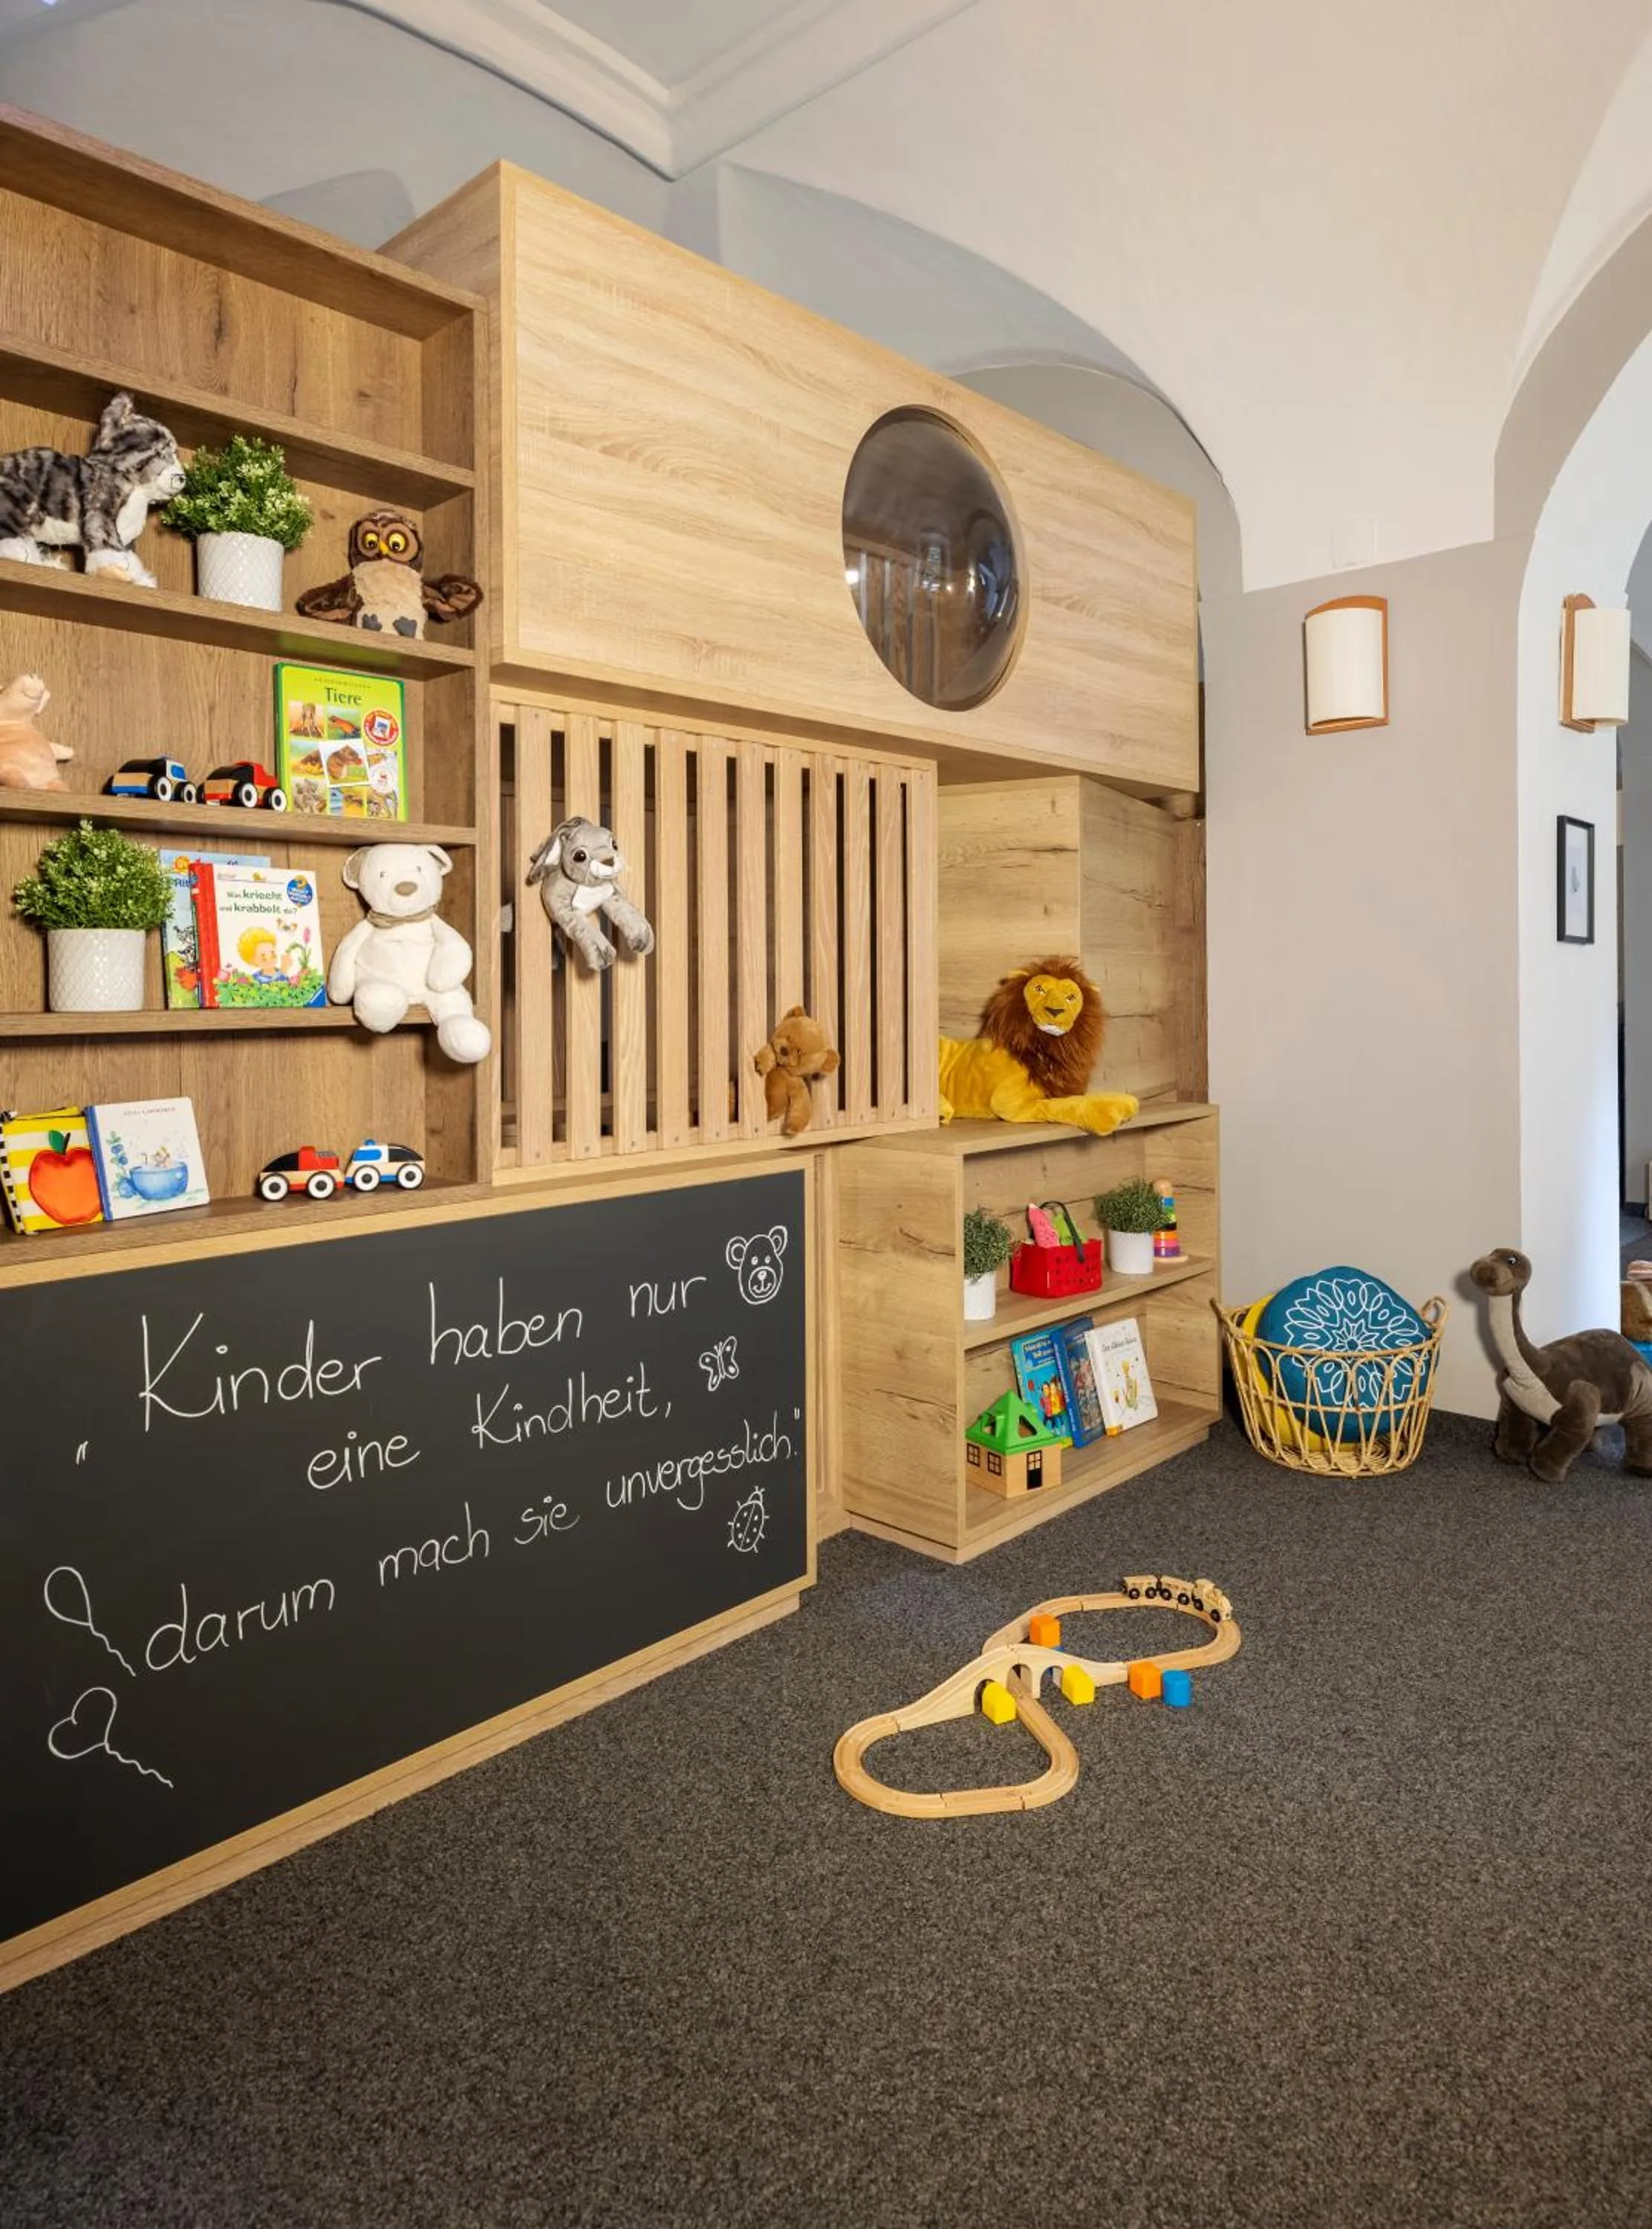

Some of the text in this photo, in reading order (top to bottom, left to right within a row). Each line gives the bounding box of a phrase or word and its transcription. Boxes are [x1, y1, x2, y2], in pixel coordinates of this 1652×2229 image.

[324, 687, 362, 707] Tiere
[234, 903, 282, 914] krabbelt
[139, 1313, 383, 1432] Kinder
[429, 1276, 583, 1365] haben
[629, 1276, 707, 1318] nur
[307, 1361, 671, 1489] eine Kindheit,
[145, 1583, 335, 1671] darum
[378, 1501, 490, 1586] mach
[513, 1495, 580, 1545] sie
